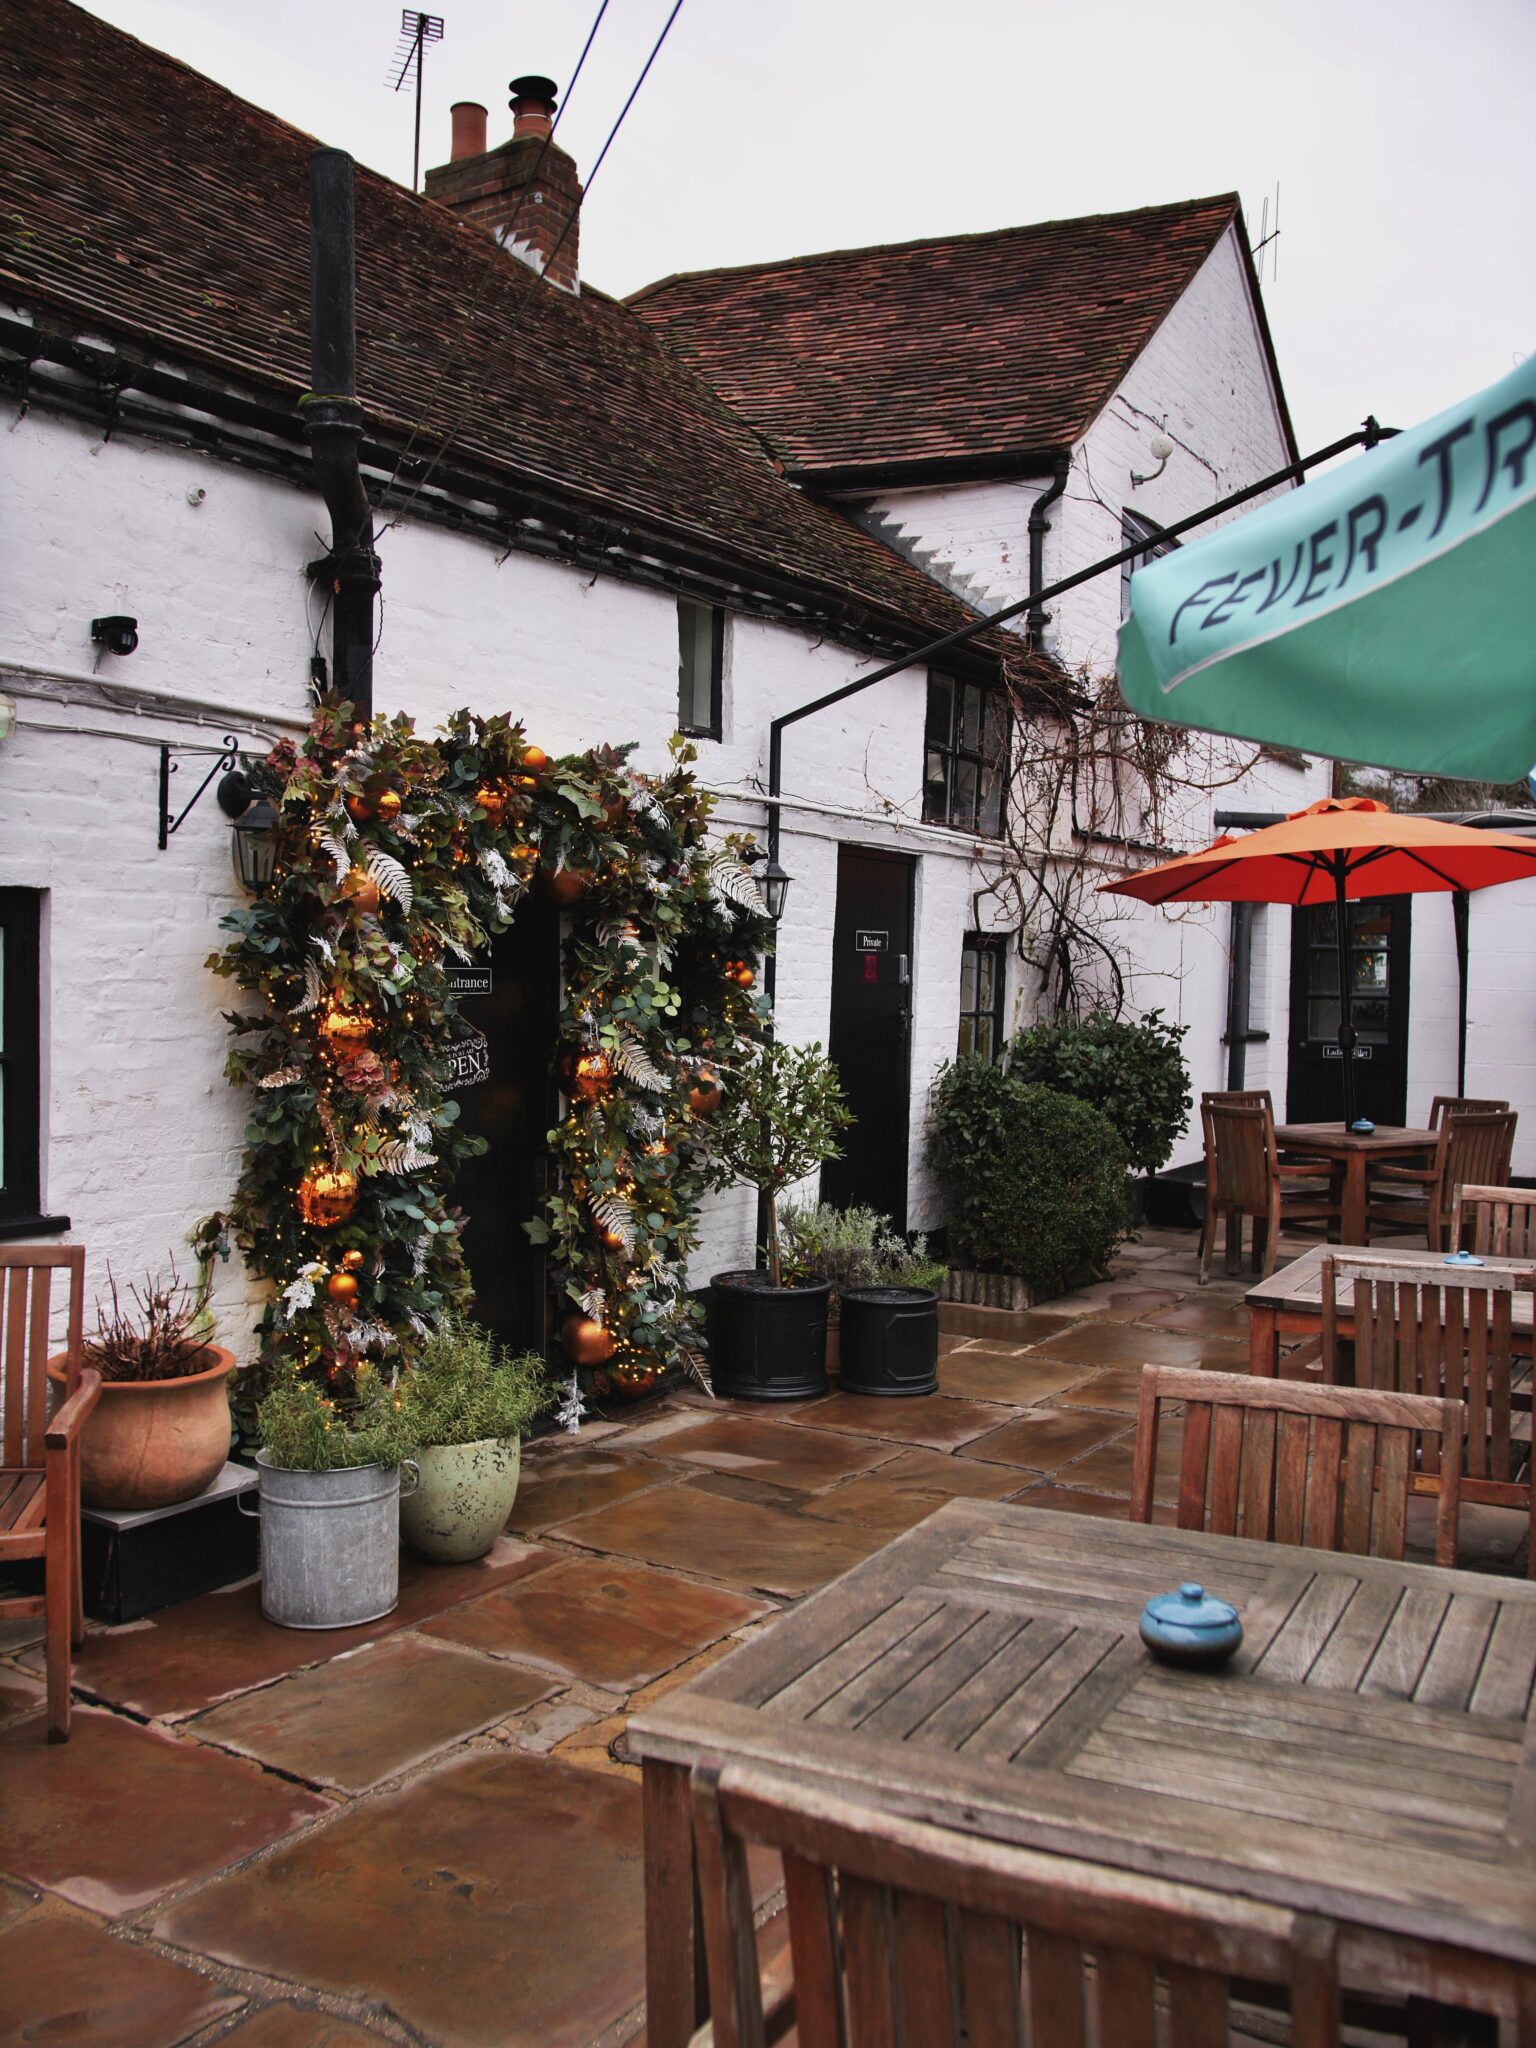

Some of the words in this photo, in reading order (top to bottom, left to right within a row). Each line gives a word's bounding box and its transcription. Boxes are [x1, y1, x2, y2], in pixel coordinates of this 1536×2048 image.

[1169, 397, 1536, 646] FEVER-TR
[863, 935, 882, 947] Private
[448, 976, 489, 989] ntrance
[1326, 1048, 1343, 1056] Ladi
[447, 1052, 481, 1078] PEN
